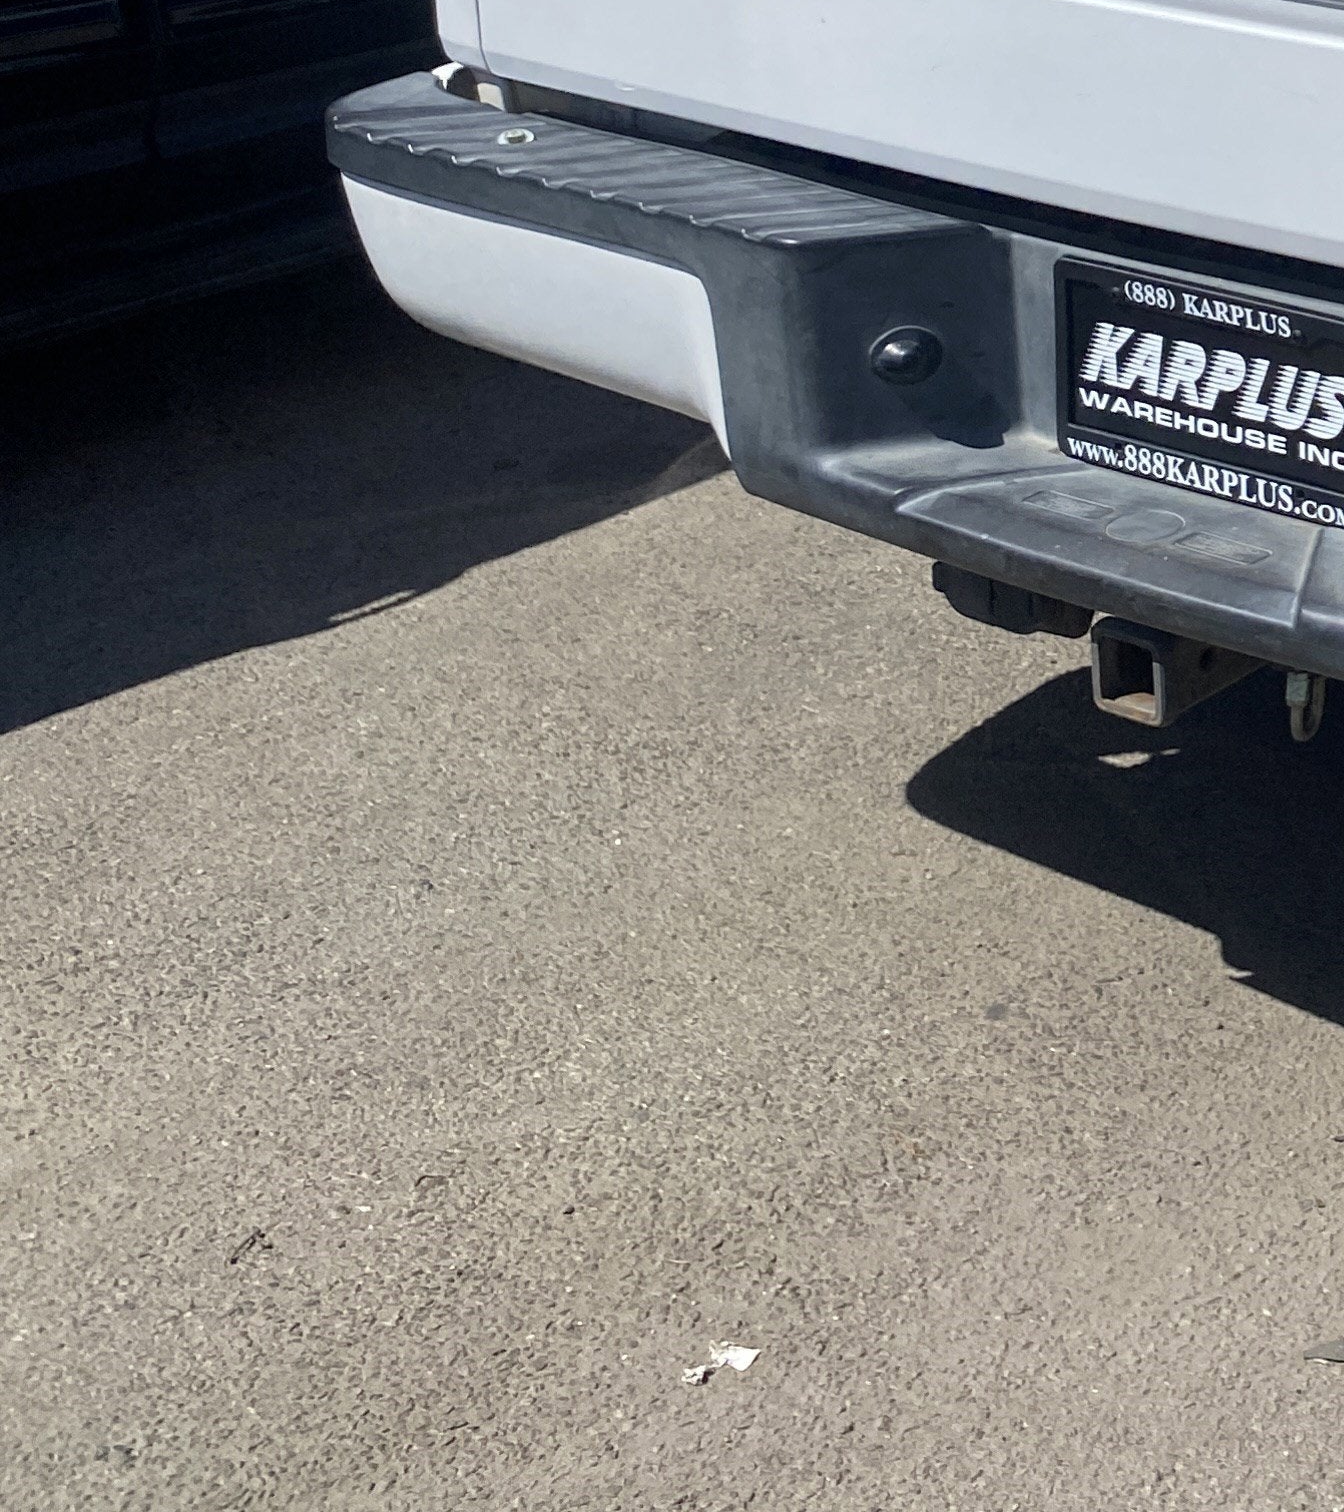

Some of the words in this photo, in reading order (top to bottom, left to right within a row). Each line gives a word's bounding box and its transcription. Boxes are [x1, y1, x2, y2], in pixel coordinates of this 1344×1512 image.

[1124, 280, 1175, 311] (888)
[1183, 293, 1292, 338] KARPLUS
[1078, 386, 1287, 455] WAREHOUSE
